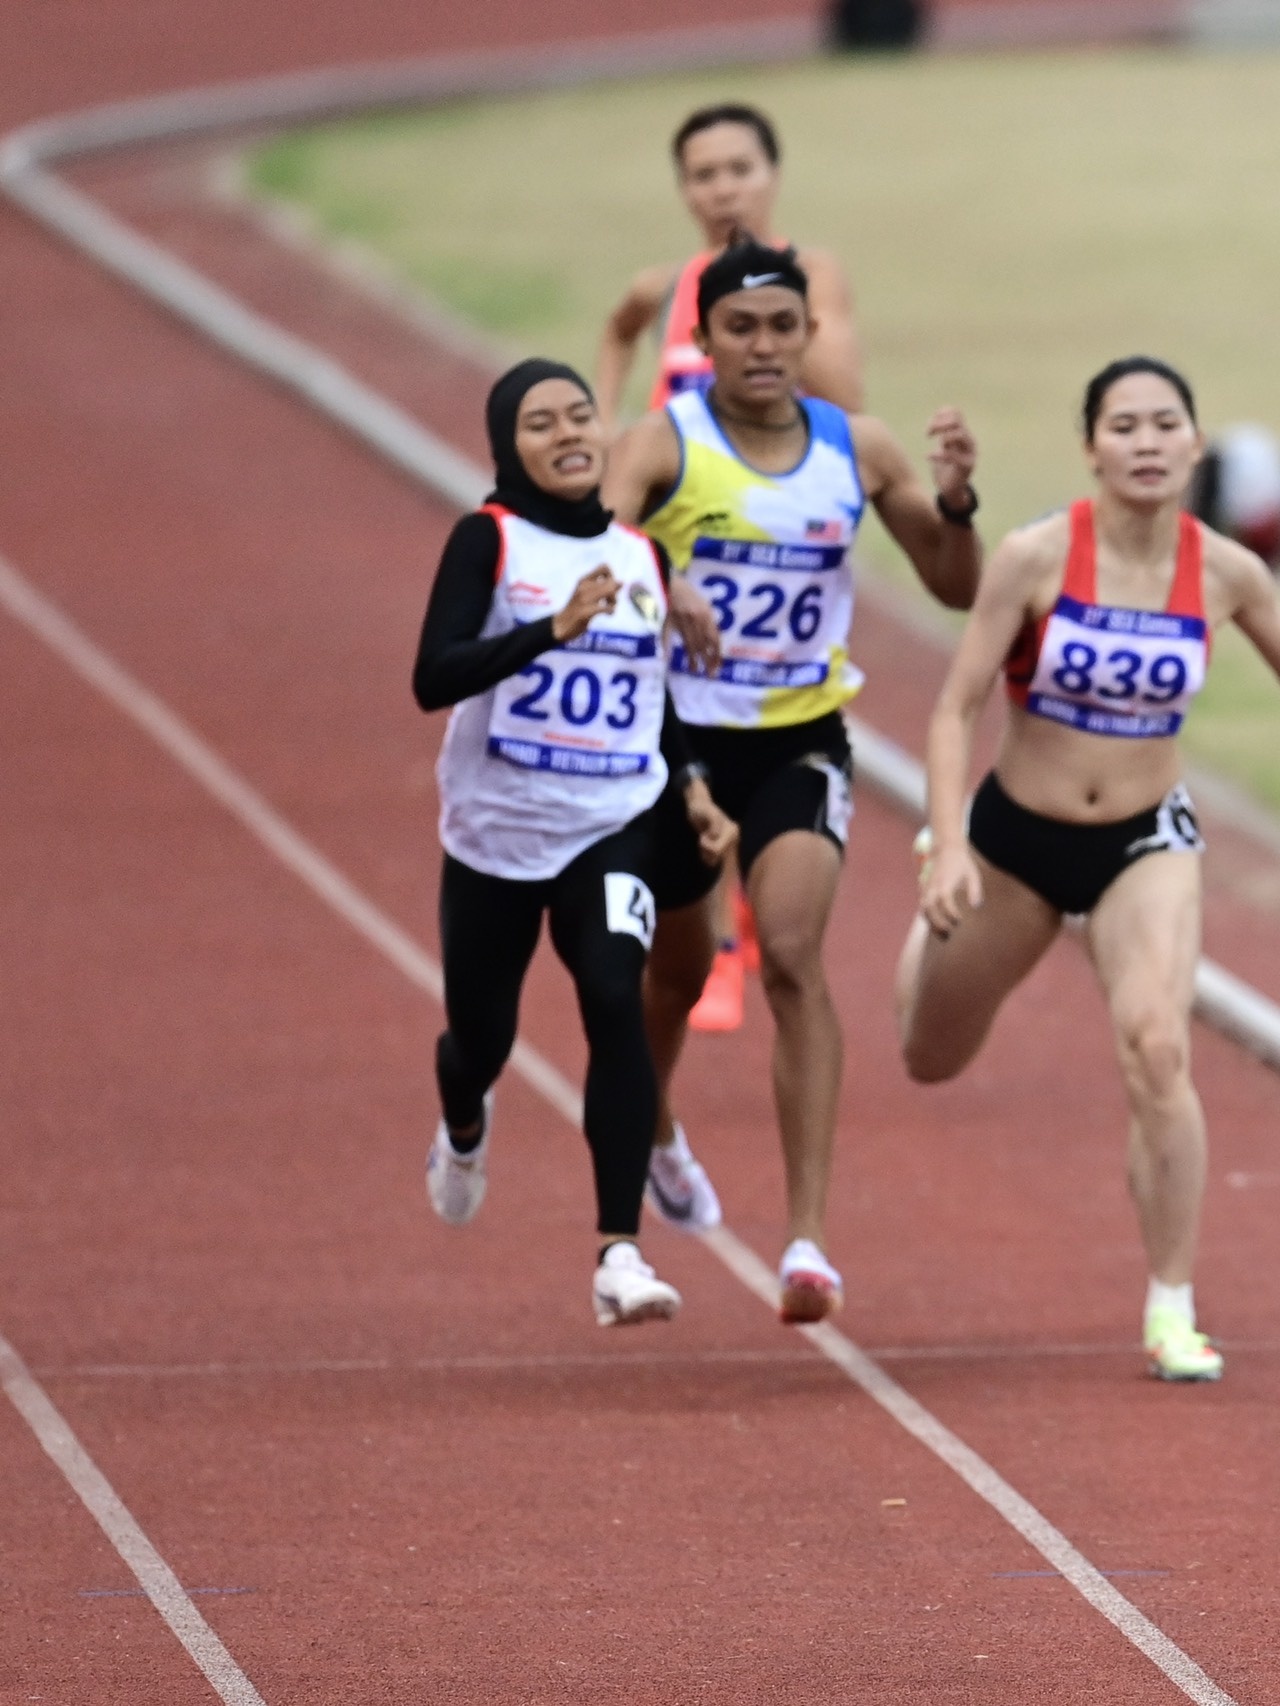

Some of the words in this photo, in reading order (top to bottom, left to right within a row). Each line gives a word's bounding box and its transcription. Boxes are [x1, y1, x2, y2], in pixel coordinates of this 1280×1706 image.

[702, 574, 822, 643] 326
[509, 663, 638, 729] 203
[1053, 642, 1187, 703] 839
